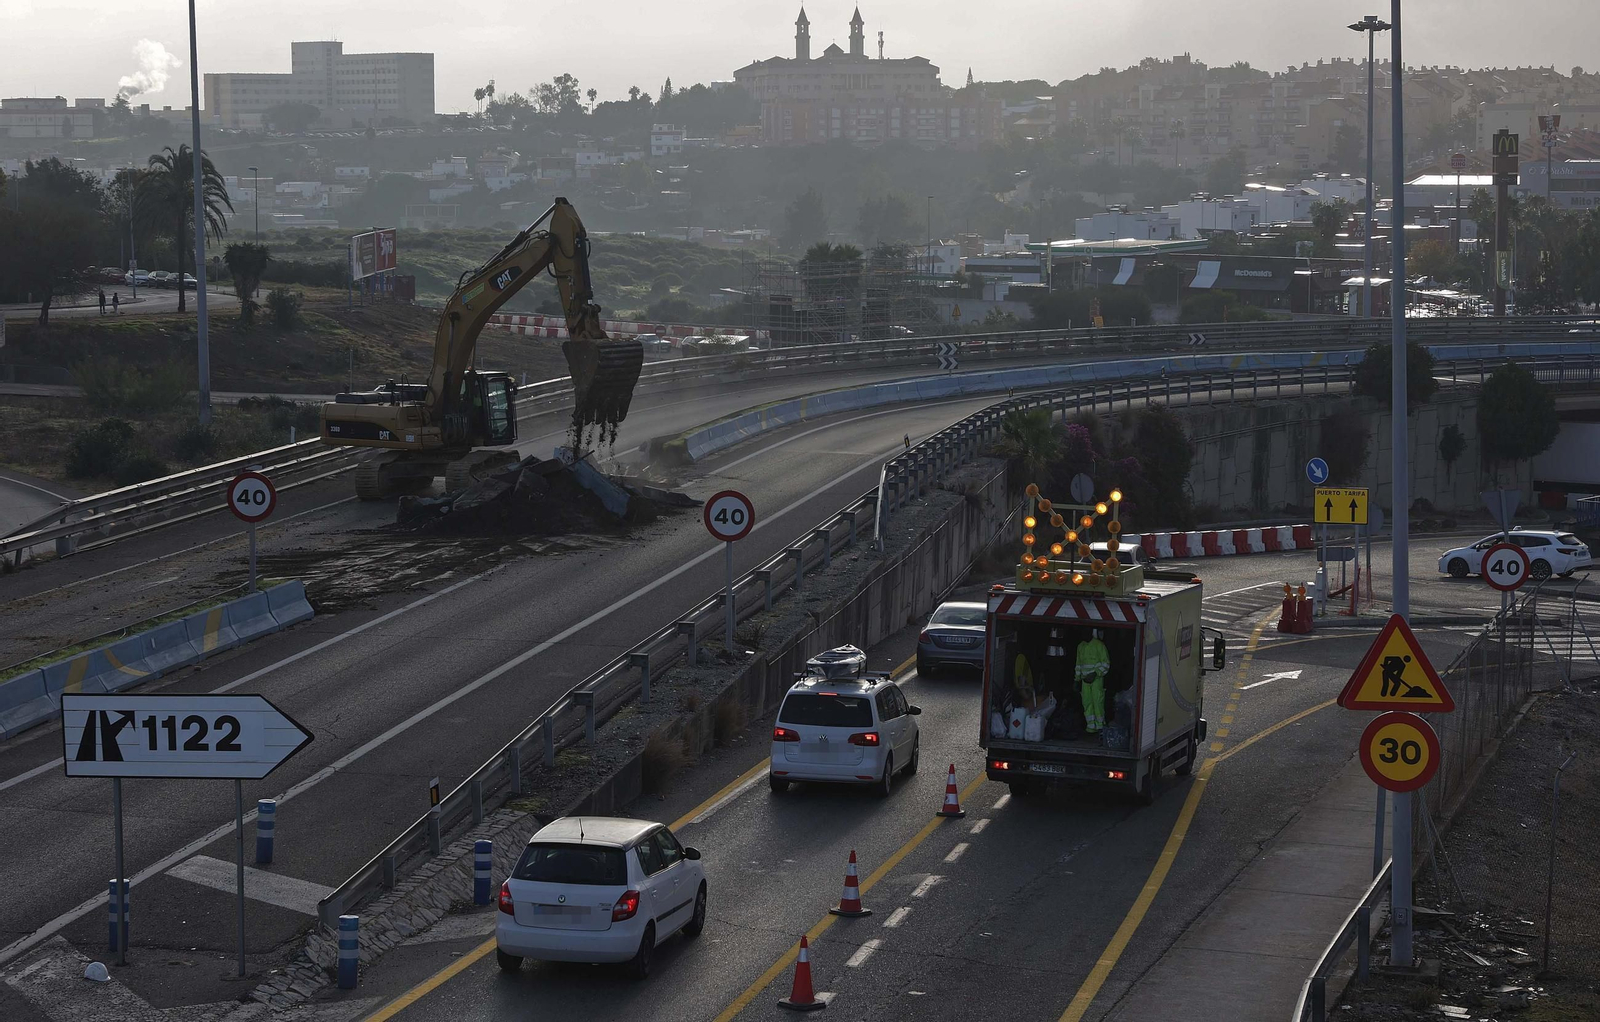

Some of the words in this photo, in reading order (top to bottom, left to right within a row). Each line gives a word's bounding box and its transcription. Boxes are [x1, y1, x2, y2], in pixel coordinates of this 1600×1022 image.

[497, 269, 512, 290] CAT
[1235, 269, 1272, 277] McDonald's
[379, 430, 390, 440] CAT
[237, 489, 266, 506] 40
[714, 508, 745, 525] 40
[1490, 559, 1520, 576] 40
[142, 714, 242, 751] 1122
[1379, 737, 1421, 765] 30
